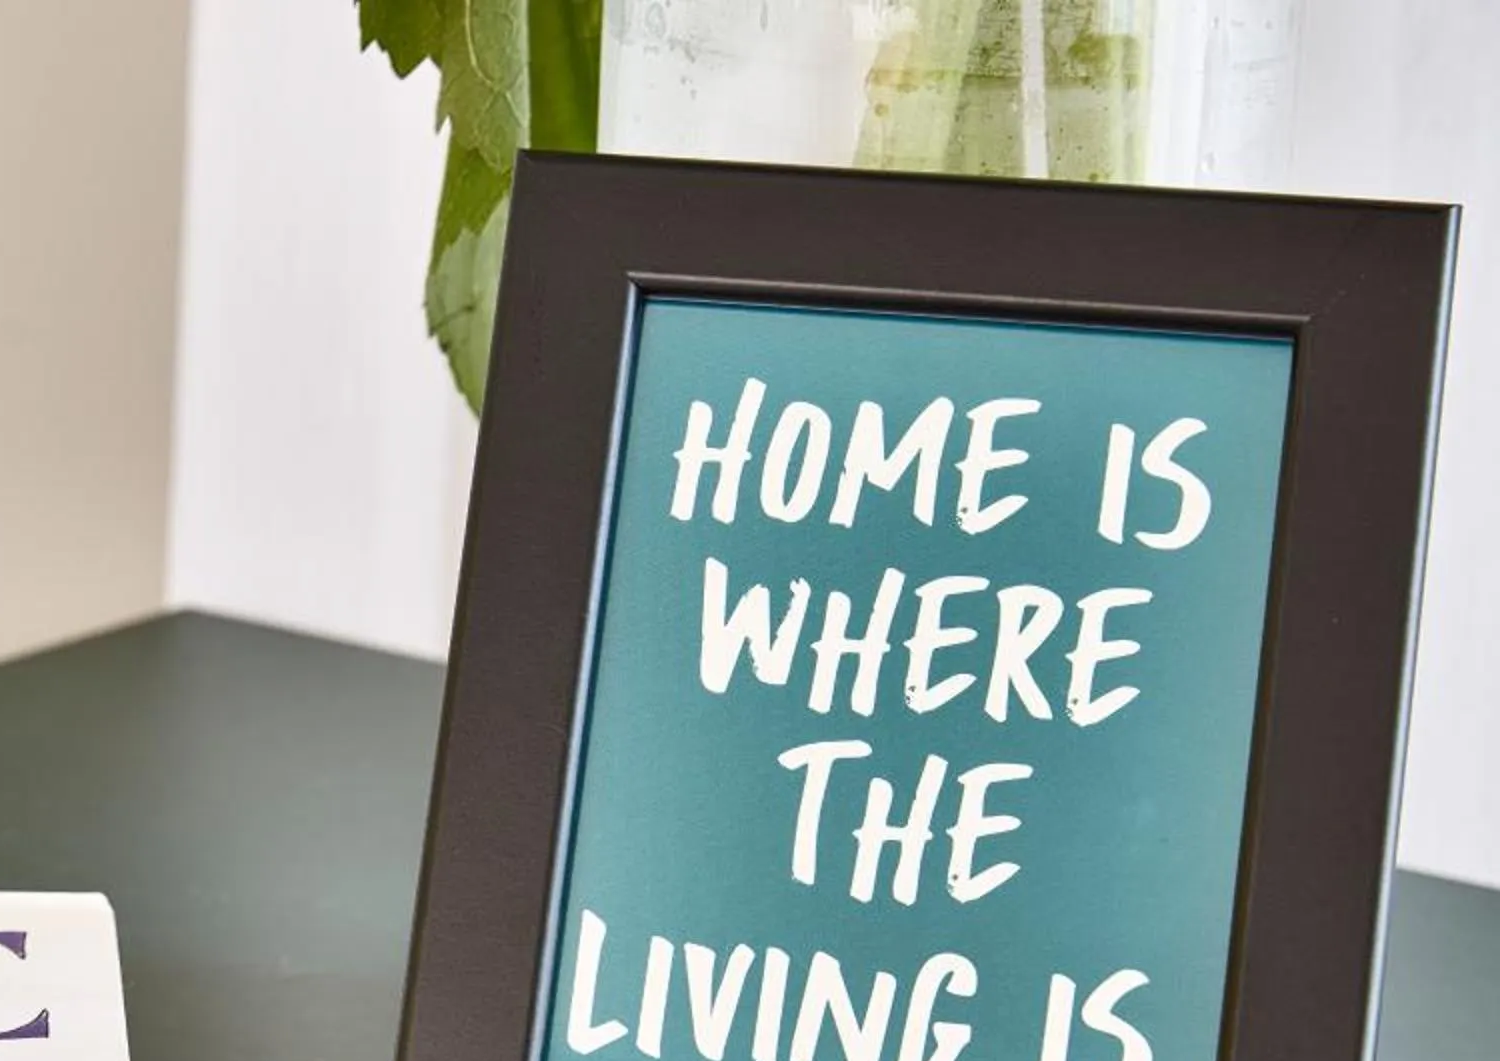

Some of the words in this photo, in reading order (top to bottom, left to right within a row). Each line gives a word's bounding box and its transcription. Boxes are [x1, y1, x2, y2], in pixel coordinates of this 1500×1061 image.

[669, 377, 1042, 535] HOME
[1097, 417, 1212, 550] IS
[699, 556, 1153, 728] WHERE
[777, 739, 1033, 906] THE
